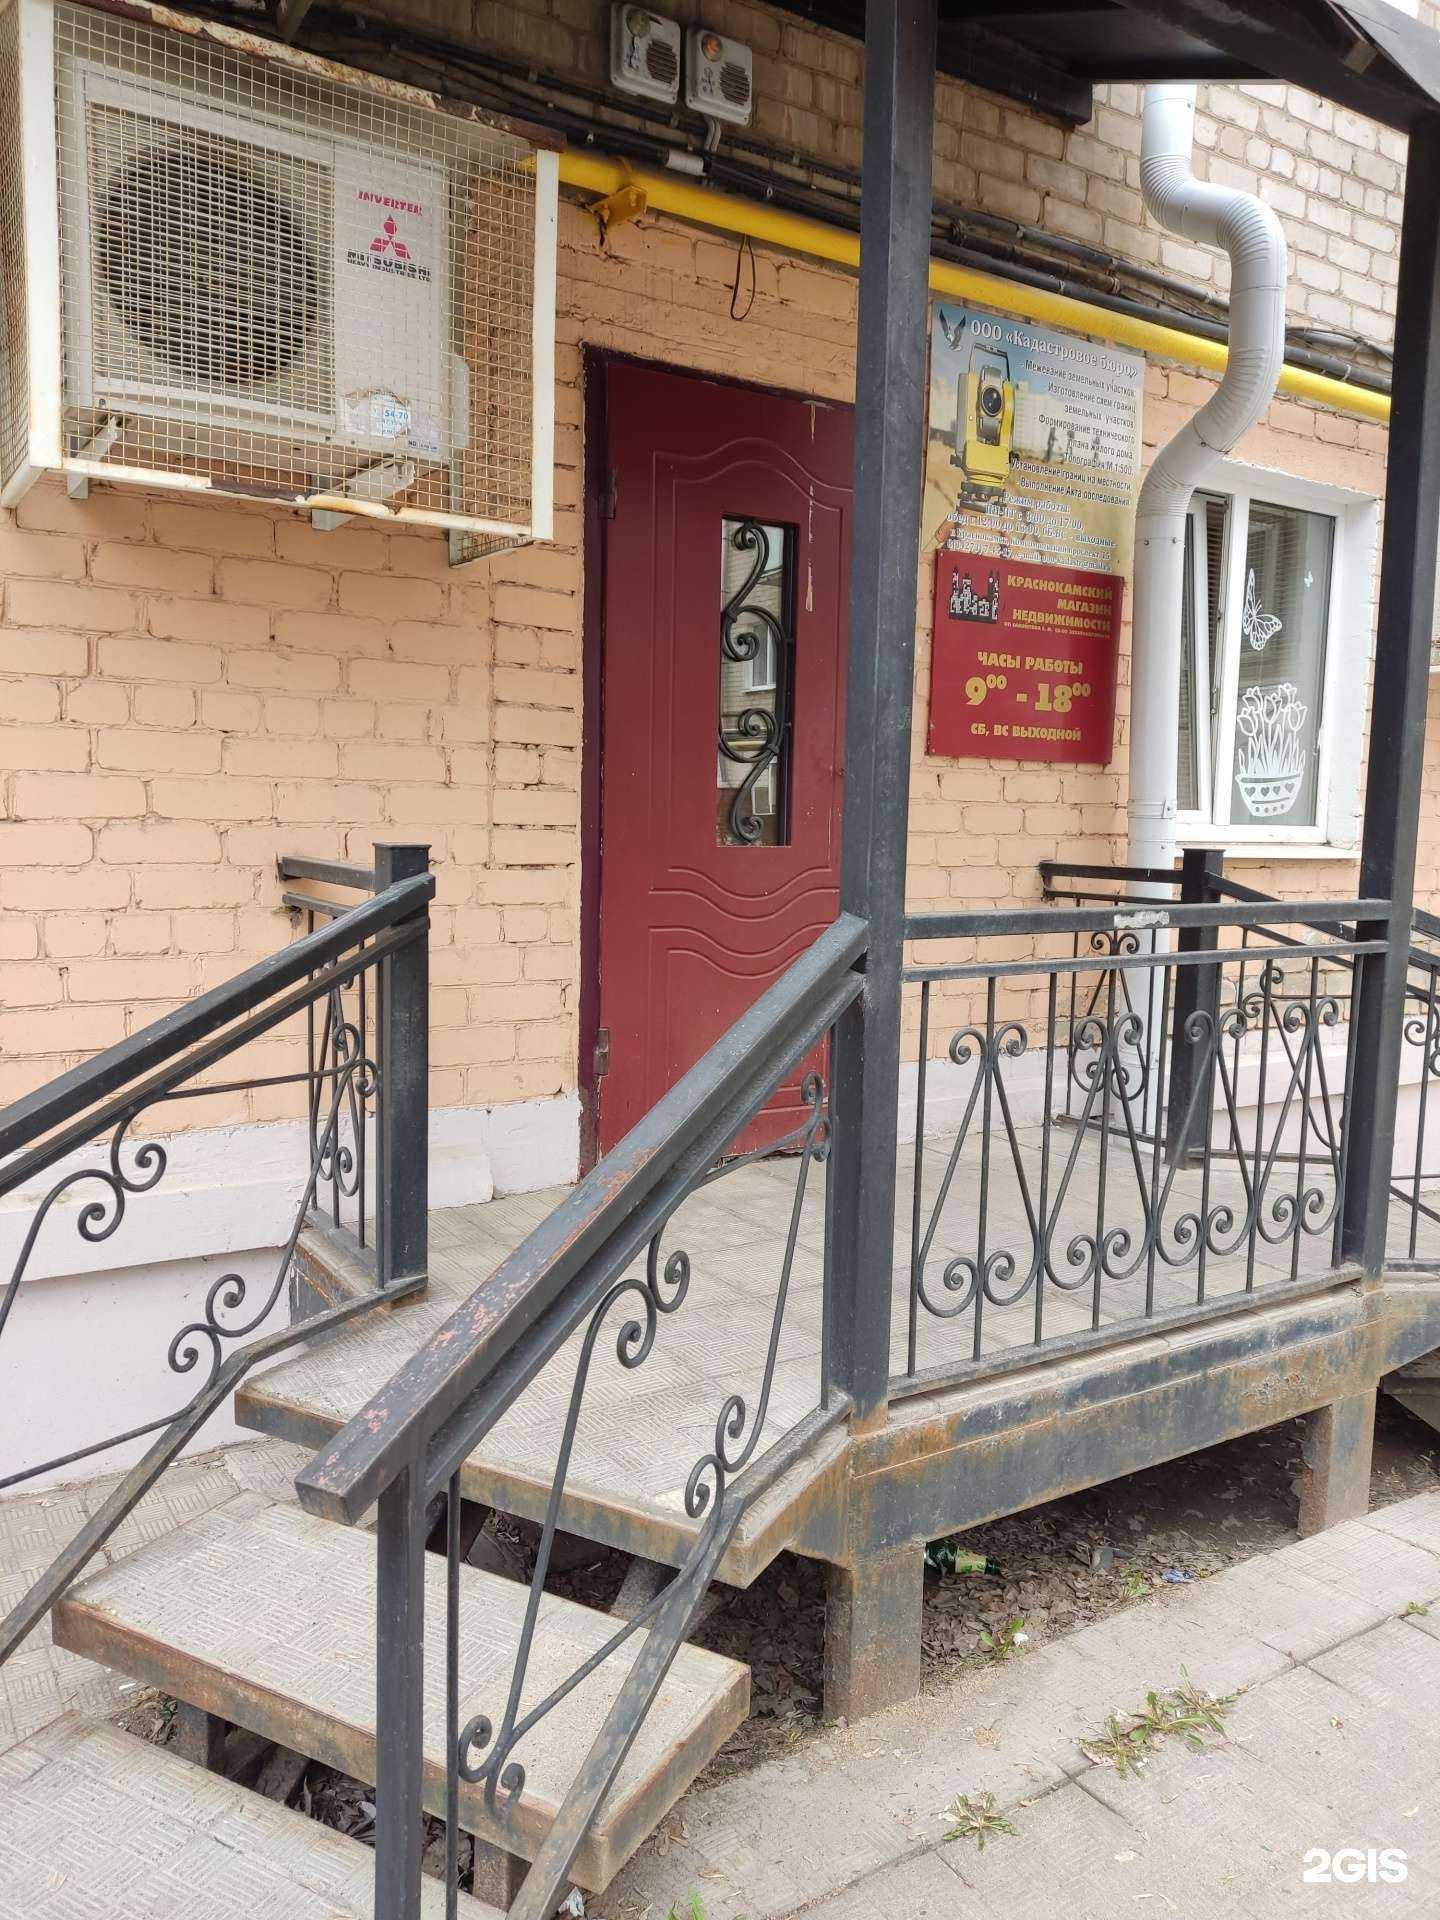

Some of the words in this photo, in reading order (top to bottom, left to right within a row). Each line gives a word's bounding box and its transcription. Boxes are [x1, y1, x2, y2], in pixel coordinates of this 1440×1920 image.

[358, 191, 422, 216] INVERTER
[971, 319, 1002, 341] ООО
[1006, 330, 1097, 366] «Кадастровое
[1007, 575, 1113, 600] КРАСНОКАМСКИЙ
[1057, 599, 1112, 615] МАГАЗИН
[1012, 609, 1111, 631] НЕДВИЖИМОСТИ
[977, 652, 1021, 669] ЧАСЫ
[1025, 656, 1083, 675] РАБОТЫ
[970, 723, 989, 737] СБ,
[993, 724, 1009, 737] ВС
[1012, 725, 1081, 741] ВЫХОДНОЙ
